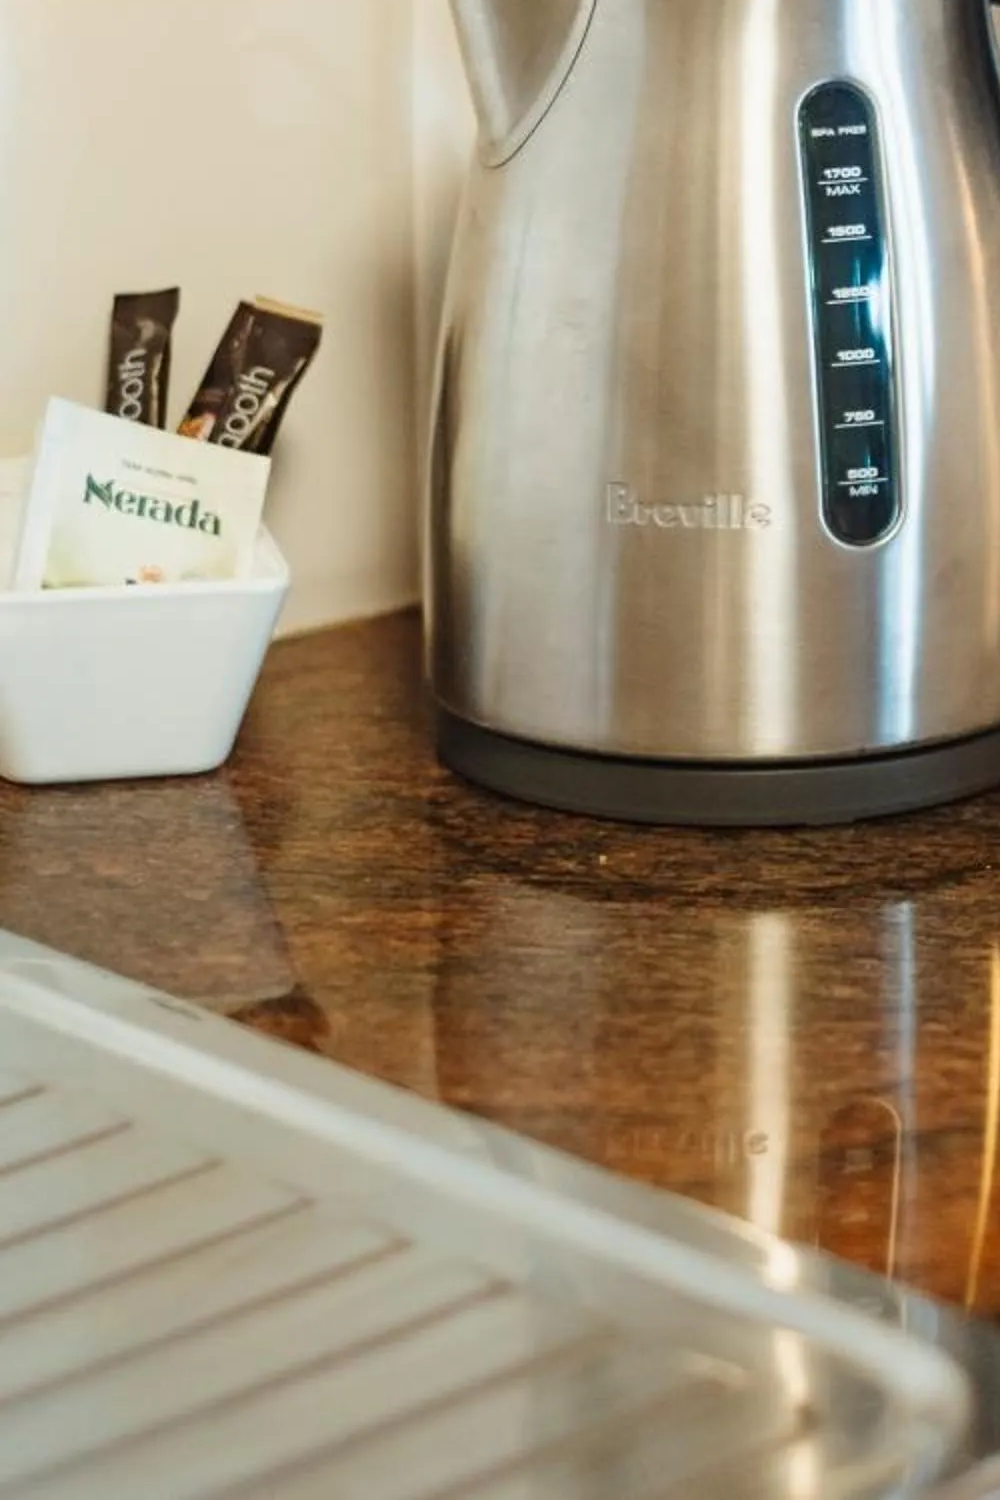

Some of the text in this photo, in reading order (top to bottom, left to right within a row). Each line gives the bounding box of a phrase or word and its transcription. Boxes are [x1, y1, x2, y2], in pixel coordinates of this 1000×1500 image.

[824, 166, 861, 178] 1700
[826, 184, 861, 196] MAX
[836, 348, 874, 360] 1000
[844, 410, 875, 421] 750
[83, 472, 221, 536] Nerada
[605, 481, 771, 528] Breville
